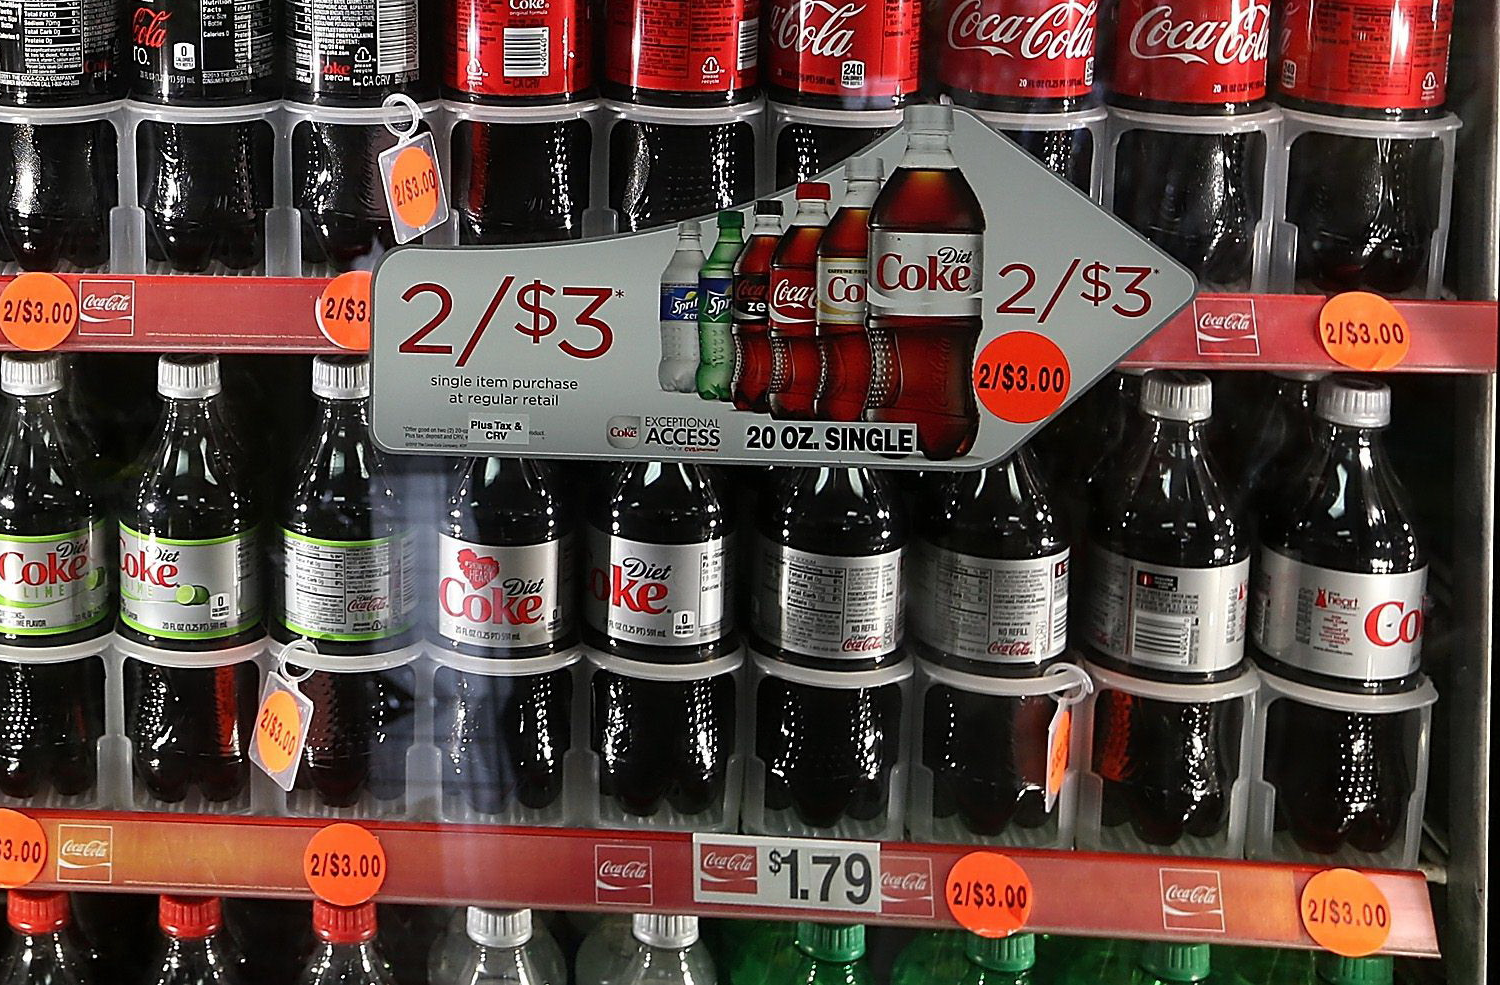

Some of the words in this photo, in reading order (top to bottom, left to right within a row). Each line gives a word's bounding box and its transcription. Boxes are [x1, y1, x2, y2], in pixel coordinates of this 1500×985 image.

[1129, 3, 1269, 66] Coca-Cola
[843, 63, 863, 76] 240
[363, 76, 374, 87] CA
[376, 75, 390, 87] CRV
[394, 170, 436, 208] 2/$3.00
[938, 246, 972, 265] Diet
[876, 252, 970, 293] Coke
[3, 300, 73, 326] 2/$3.00
[83, 293, 130, 314] Coca-Cola
[1200, 310, 1251, 334] Coca-Cola
[1325, 320, 1404, 348] 2/$3.00
[430, 374, 472, 392] single
[476, 375, 506, 389] item
[512, 377, 578, 393] purchase
[978, 367, 1065, 395] 2/$3.00
[449, 394, 463, 406] at
[467, 393, 517, 410] regular
[522, 393, 559, 407] retail
[471, 420, 493, 430] Plus
[494, 421, 511, 431] Tax
[514, 422, 522, 431] &
[645, 416, 720, 428] EXCEPTIONAL
[485, 431, 507, 440] CRV
[610, 427, 637, 439] Coke
[645, 428, 721, 447] ACCESS
[746, 425, 776, 450] 20
[781, 426, 820, 451] OZ.
[825, 426, 913, 453] SINGLE
[57, 540, 88, 558] Diet
[622, 557, 673, 581] Diet
[24, 585, 65, 599] LIME
[503, 578, 545, 594] Diet
[347, 597, 388, 612] Coca-Cola
[439, 577, 543, 625] Coke
[860, 624, 877, 633] REFILL
[842, 636, 883, 652] Coca-Cola
[260, 709, 298, 758] 2/$3.00
[310, 853, 382, 879] 2/$3.00
[599, 859, 647, 881] Coca-Cola
[702, 850, 753, 873] Coca-Cola
[769, 848, 873, 905] $1.79
[952, 880, 1028, 909] 2/$3.00
[1165, 882, 1215, 905] Coca-Cola
[1308, 898, 1387, 928] 2/$3.00
